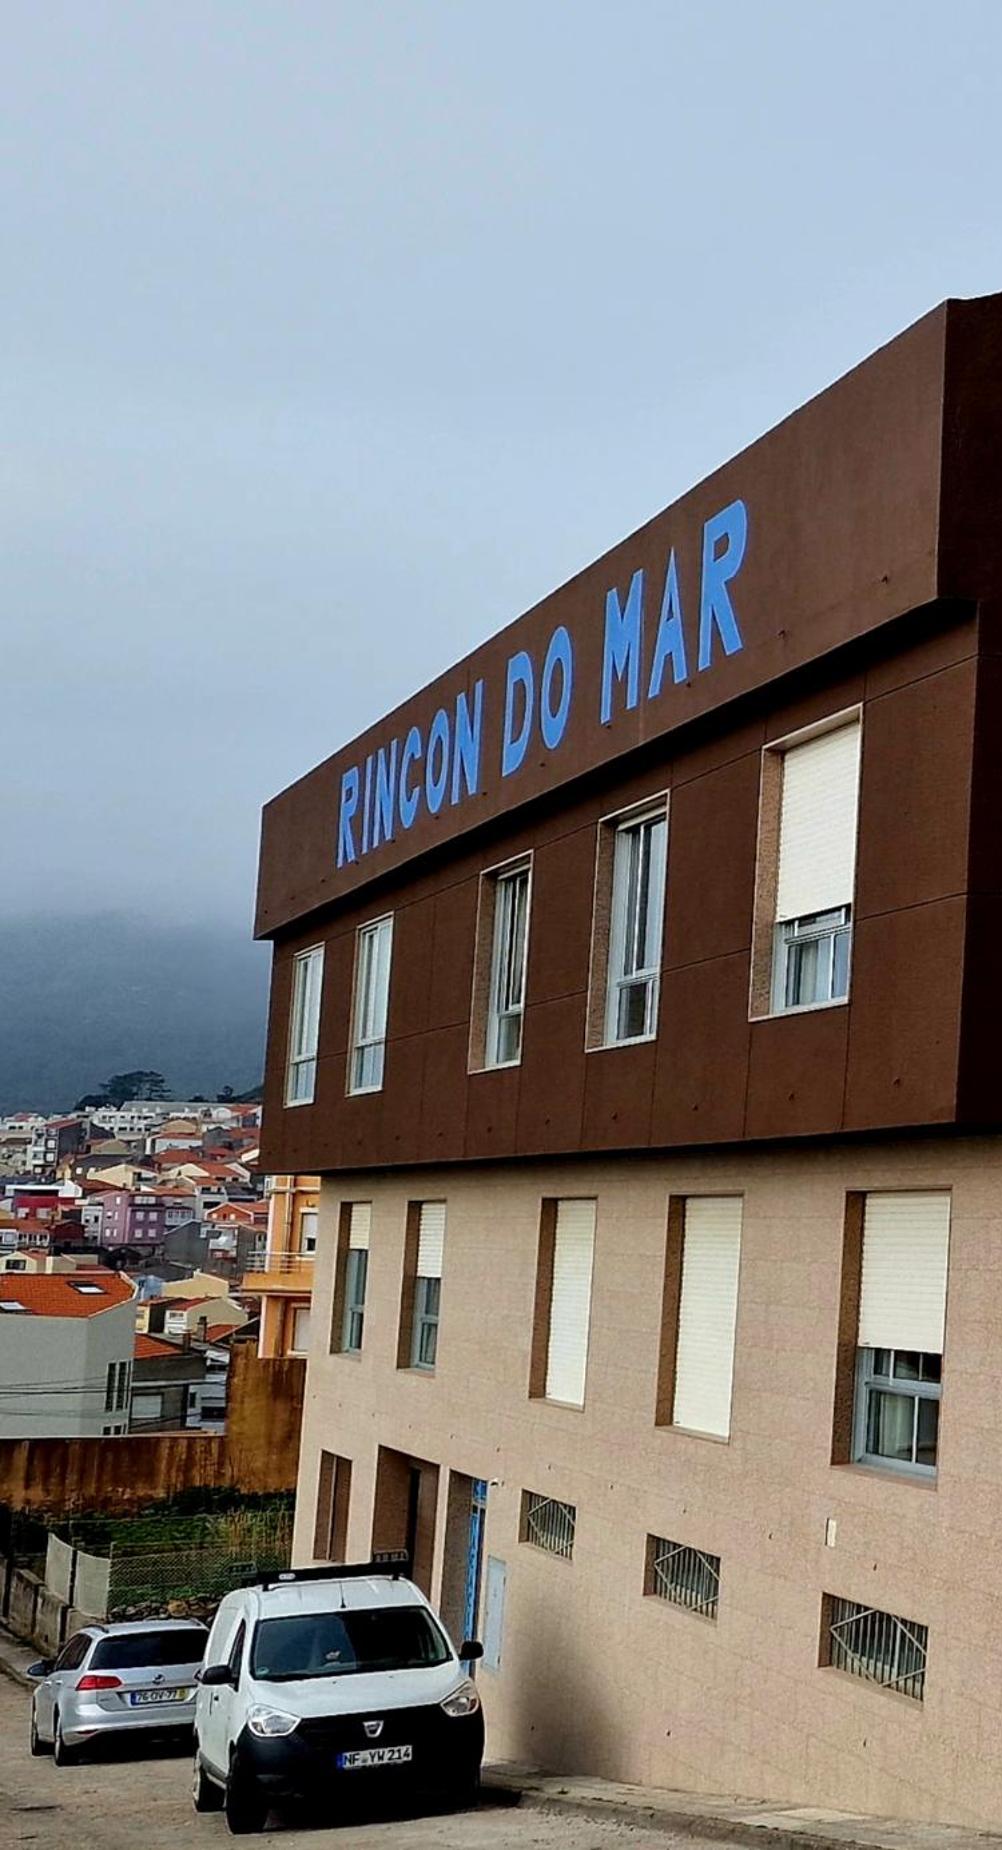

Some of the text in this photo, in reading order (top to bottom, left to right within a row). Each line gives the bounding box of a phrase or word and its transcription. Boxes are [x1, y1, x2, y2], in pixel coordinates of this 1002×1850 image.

[337, 499, 749, 869] RINCON DO MAR
